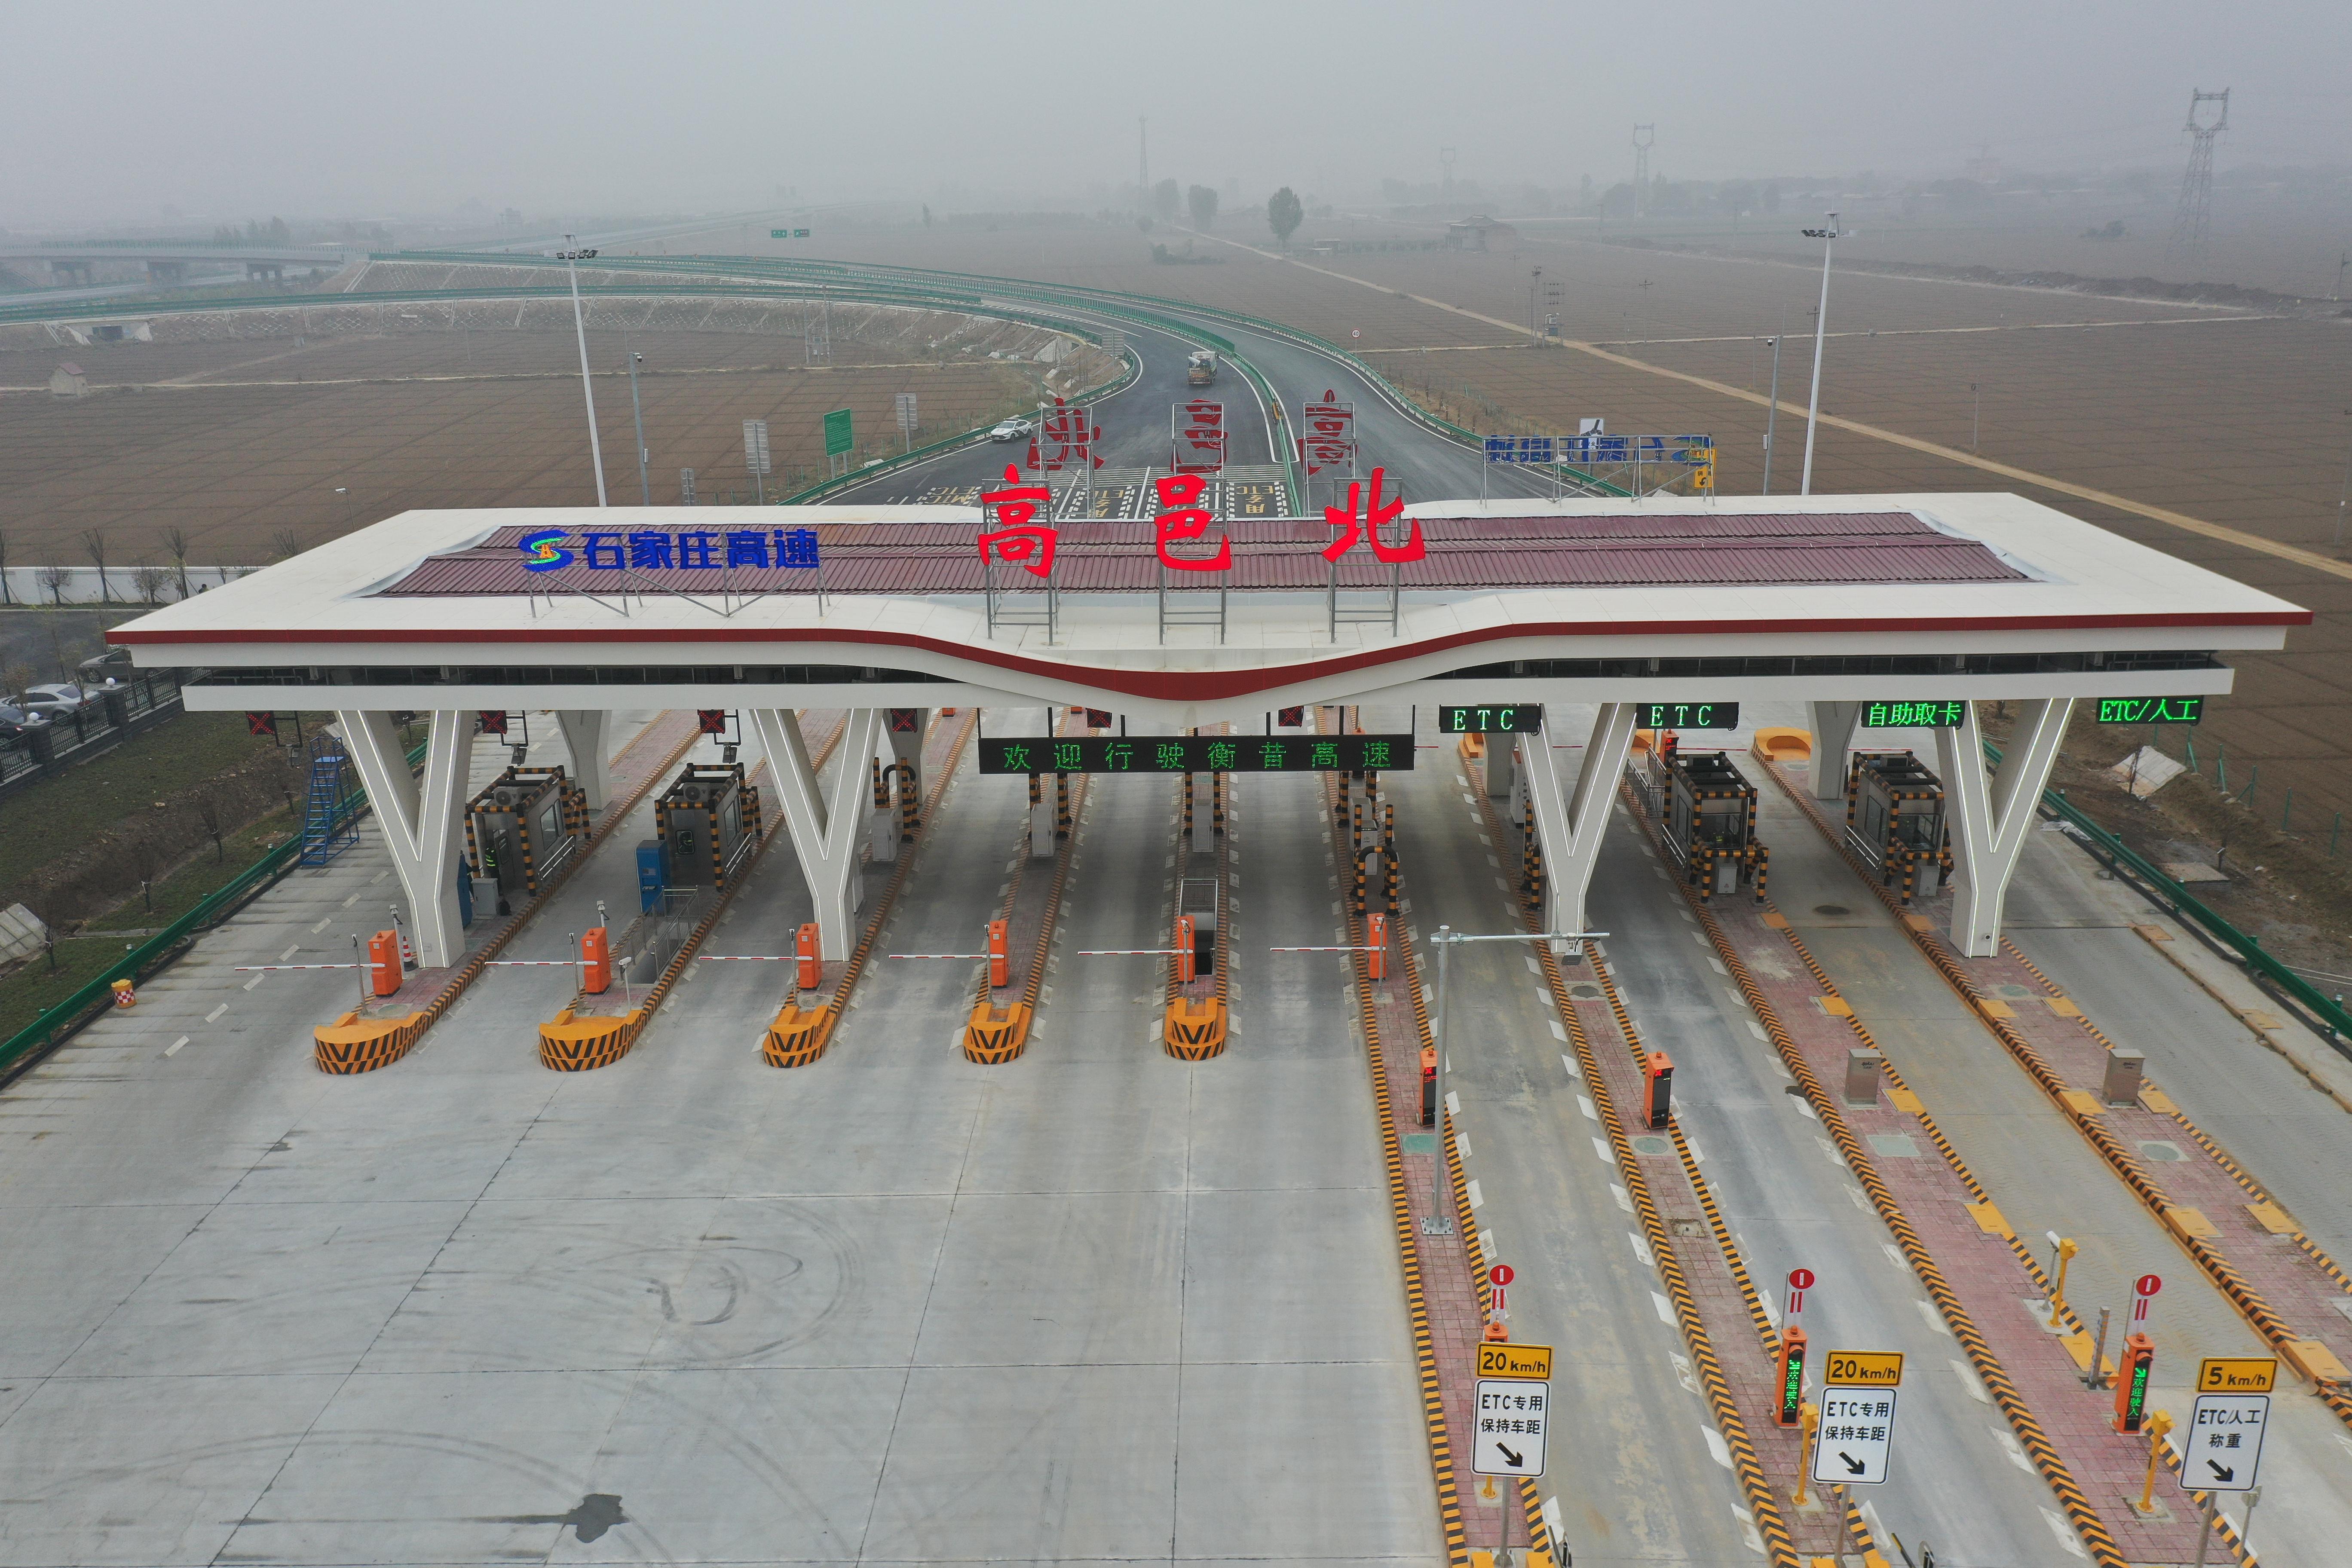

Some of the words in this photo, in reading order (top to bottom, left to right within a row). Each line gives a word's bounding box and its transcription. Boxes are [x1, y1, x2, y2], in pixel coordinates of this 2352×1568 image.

[1236, 485, 1273, 494] ETC
[978, 463, 1426, 578] 高邑北
[582, 528, 820, 570] 石家庄高速
[1453, 710, 1513, 730] ETC
[1650, 705, 1712, 726] ETC
[1868, 702, 1962, 726] 自助取卡
[2099, 698, 2199, 722] ETC/人工
[1003, 741, 1390, 771] 欢迎行驶衡昔高速
[1482, 1351, 1507, 1371] 20
[1510, 1360, 1546, 1372] km/h
[1831, 1360, 1857, 1378] 20
[1859, 1367, 1896, 1379] km/h
[2208, 1366, 2223, 1385] 5
[2226, 1373, 2266, 1386] km/h
[1482, 1394, 1543, 1411] ETC专用
[2127, 1378, 2144, 1416] 欢迎驶入
[1827, 1402, 1890, 1418] ETC专用
[2198, 1409, 2261, 1424] ETC/人工
[1481, 1418, 1540, 1434] 保持车距
[1825, 1425, 1886, 1441] 保持车距
[2208, 1433, 2242, 1448] 称重
